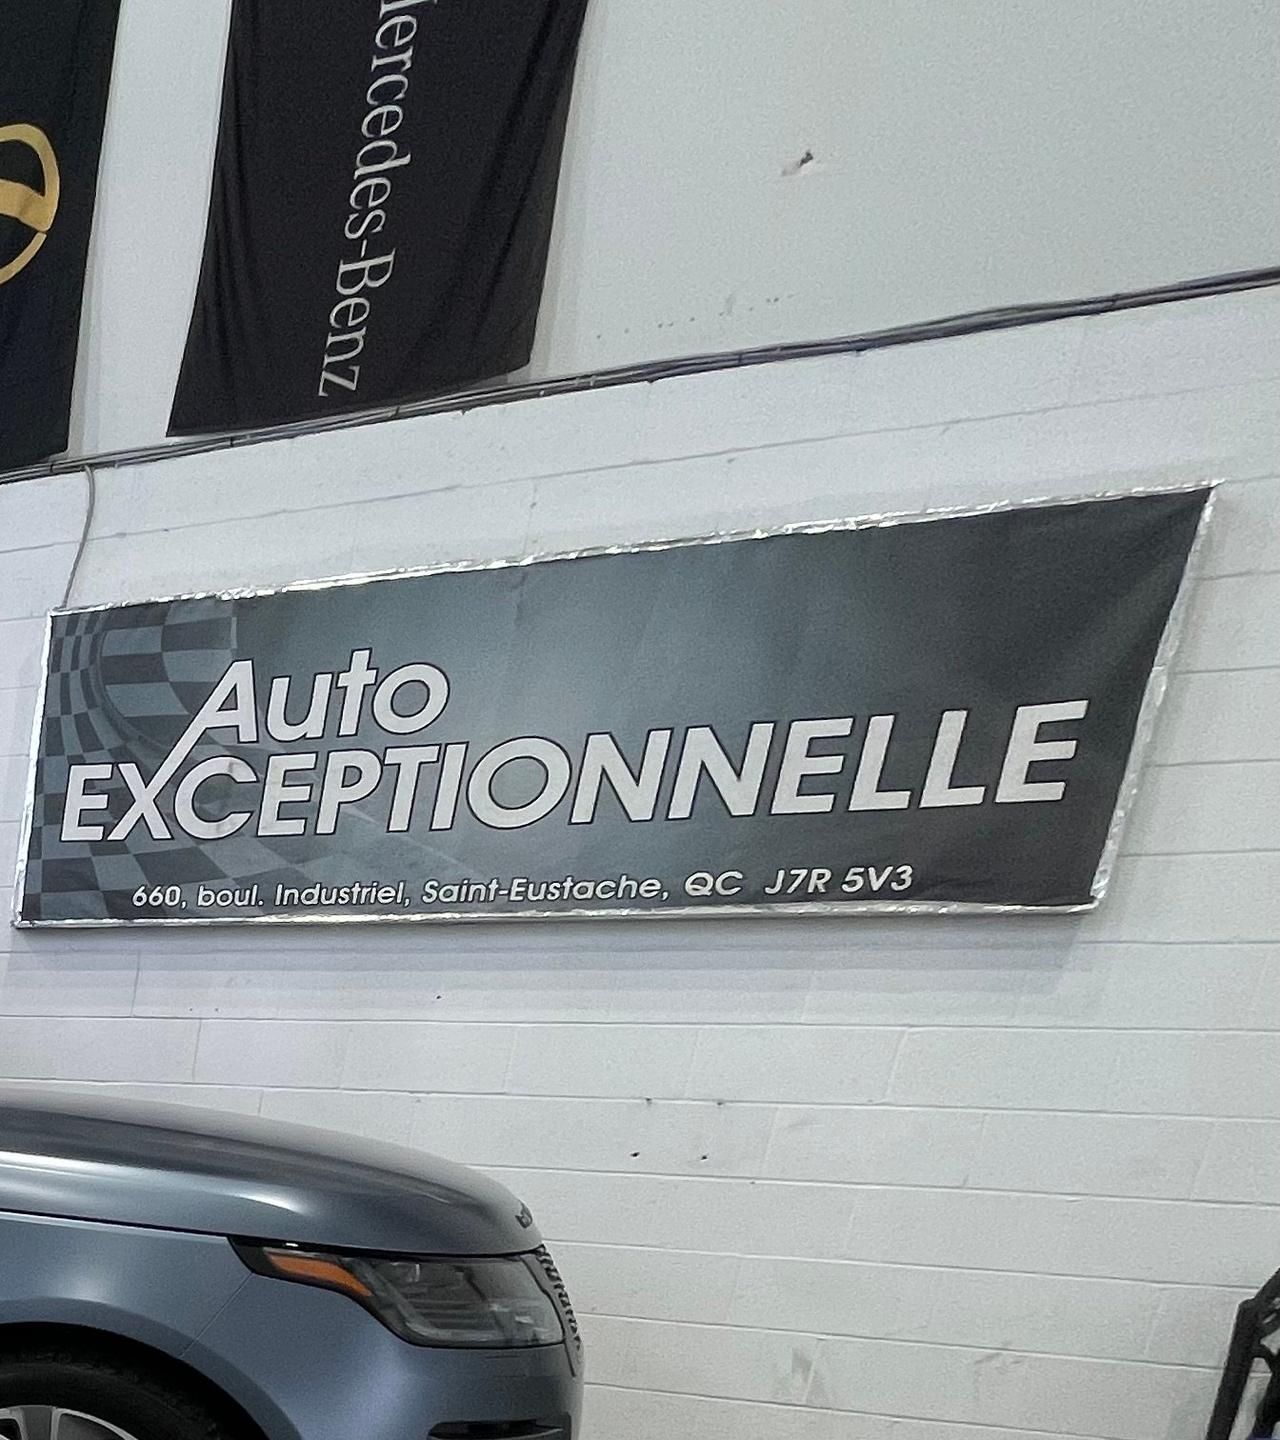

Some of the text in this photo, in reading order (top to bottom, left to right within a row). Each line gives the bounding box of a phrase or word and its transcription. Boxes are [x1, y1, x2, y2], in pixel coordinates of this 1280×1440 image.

[170, 648, 450, 766] Auto
[59, 699, 1089, 843] EXCEPTIONNELLE
[132, 864, 915, 909] 660, boul. Industriel, Saint-Eustache, QC J7R 5V3
